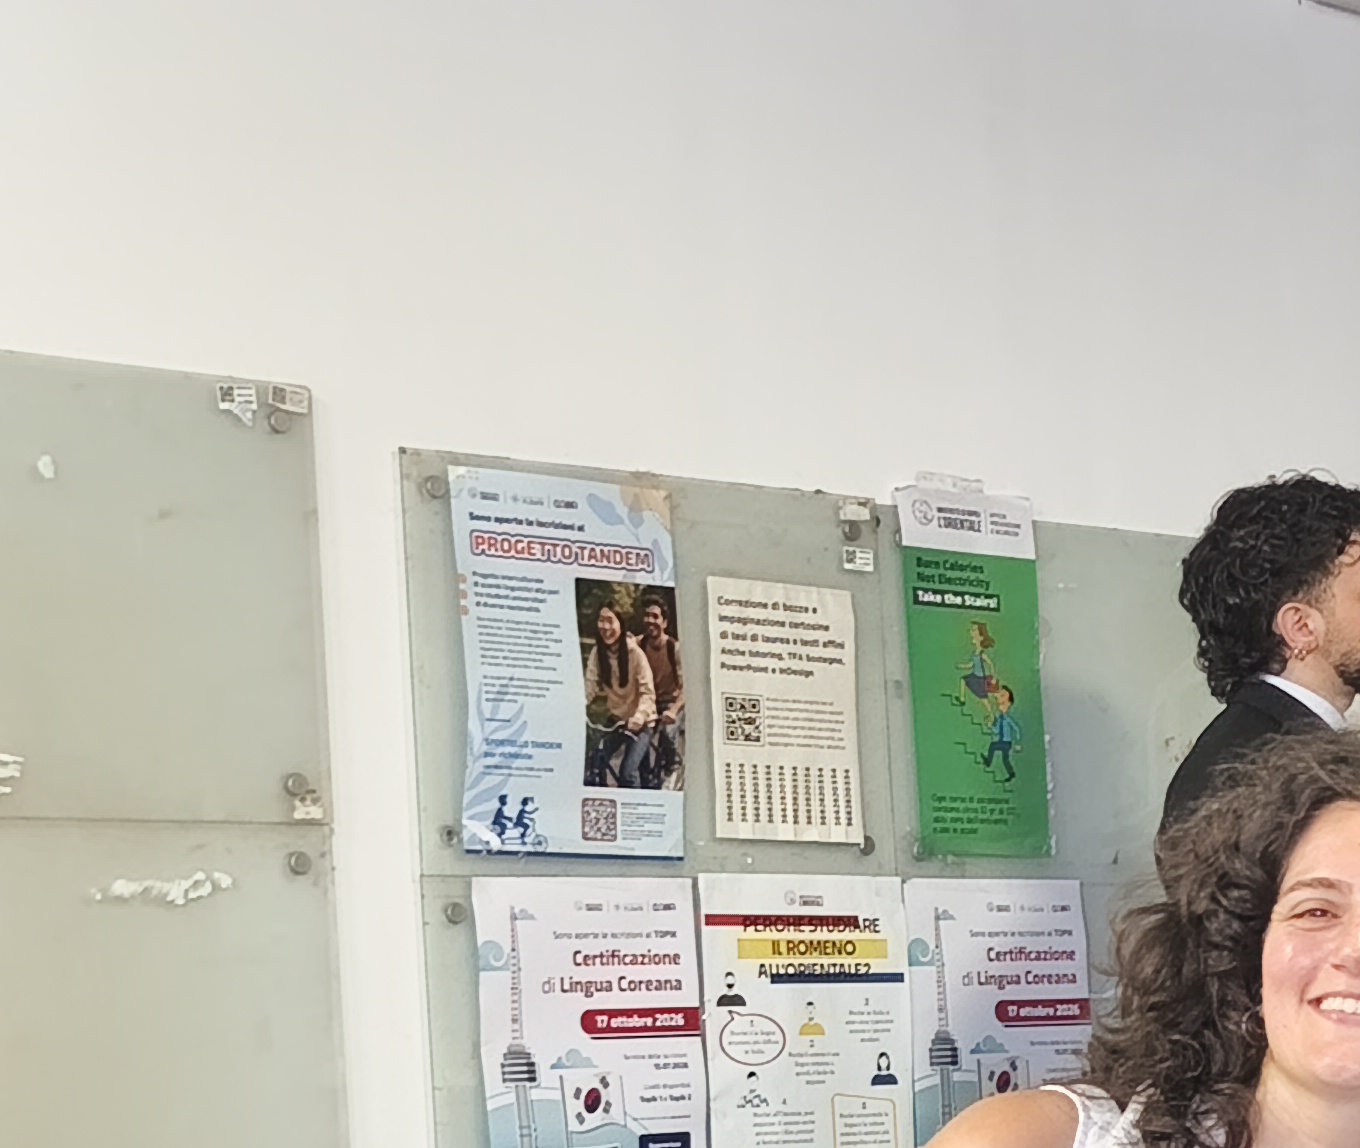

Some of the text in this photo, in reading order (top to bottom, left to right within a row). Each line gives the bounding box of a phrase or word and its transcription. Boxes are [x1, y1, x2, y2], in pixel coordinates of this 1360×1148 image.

[474, 535, 650, 568] PROGETTO TANDEM
[916, 557, 984, 574] Burn Calories
[917, 572, 990, 591] Not Electricity
[717, 596, 768, 609] Correzione
[917, 590, 998, 608] Take the Stairs!
[720, 630, 729, 640] di
[731, 632, 747, 641] tesi
[750, 633, 759, 642] di
[772, 940, 856, 956] IL ROMENO
[987, 946, 1076, 963] Certificazione
[572, 949, 681, 967] Certificazione
[542, 976, 683, 998] di Lingua Coreana
[962, 970, 1077, 990] di Lingua Coreana
[1007, 1004, 1080, 1017] 17 ottobre 2026
[595, 1012, 685, 1028] 17 ottobre 2026
